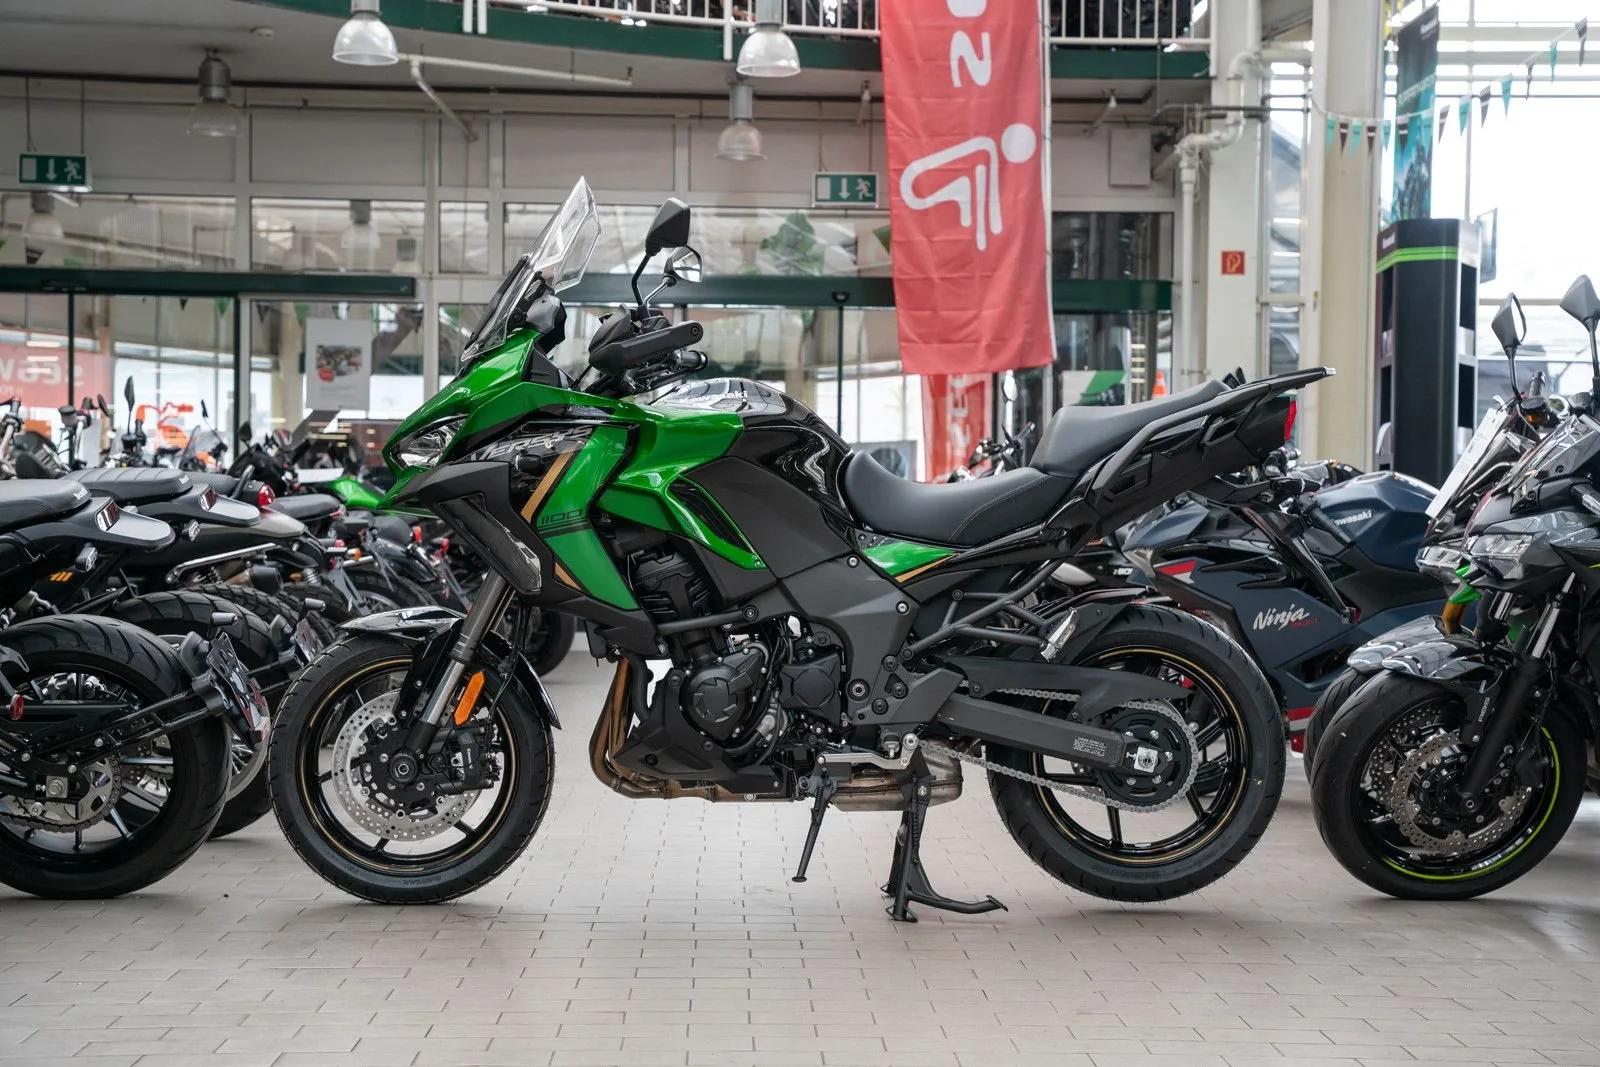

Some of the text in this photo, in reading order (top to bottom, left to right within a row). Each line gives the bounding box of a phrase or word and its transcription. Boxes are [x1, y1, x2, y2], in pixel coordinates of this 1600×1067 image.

[470, 424, 592, 461] VERSYS
[541, 508, 582, 525] 1100
[1333, 509, 1372, 526] awasaki
[1252, 603, 1310, 631] Ninja
